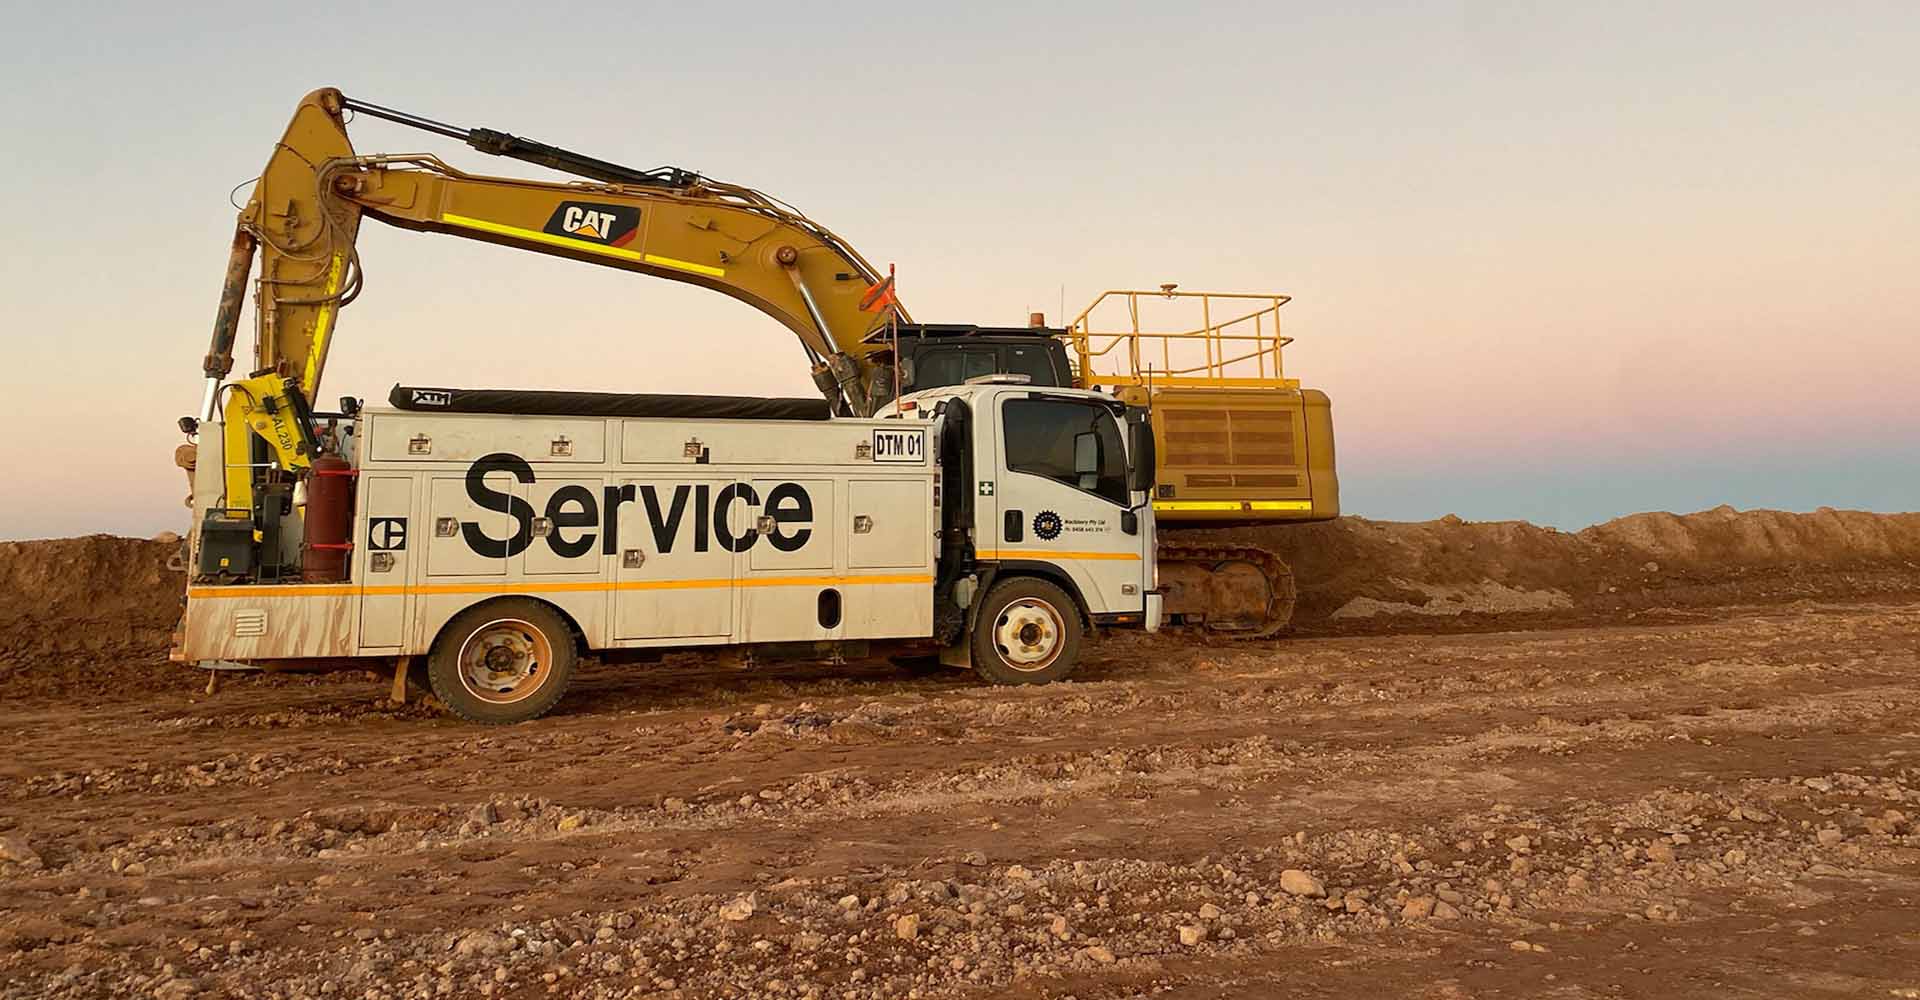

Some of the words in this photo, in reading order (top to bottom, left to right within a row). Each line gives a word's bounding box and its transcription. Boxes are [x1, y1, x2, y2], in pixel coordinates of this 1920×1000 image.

[562, 206, 617, 240] CAT
[413, 390, 449, 405] XTM
[277, 431, 293, 450] 230
[876, 434, 904, 456] DTM
[907, 434, 921, 456] 01
[461, 449, 813, 558] Service
